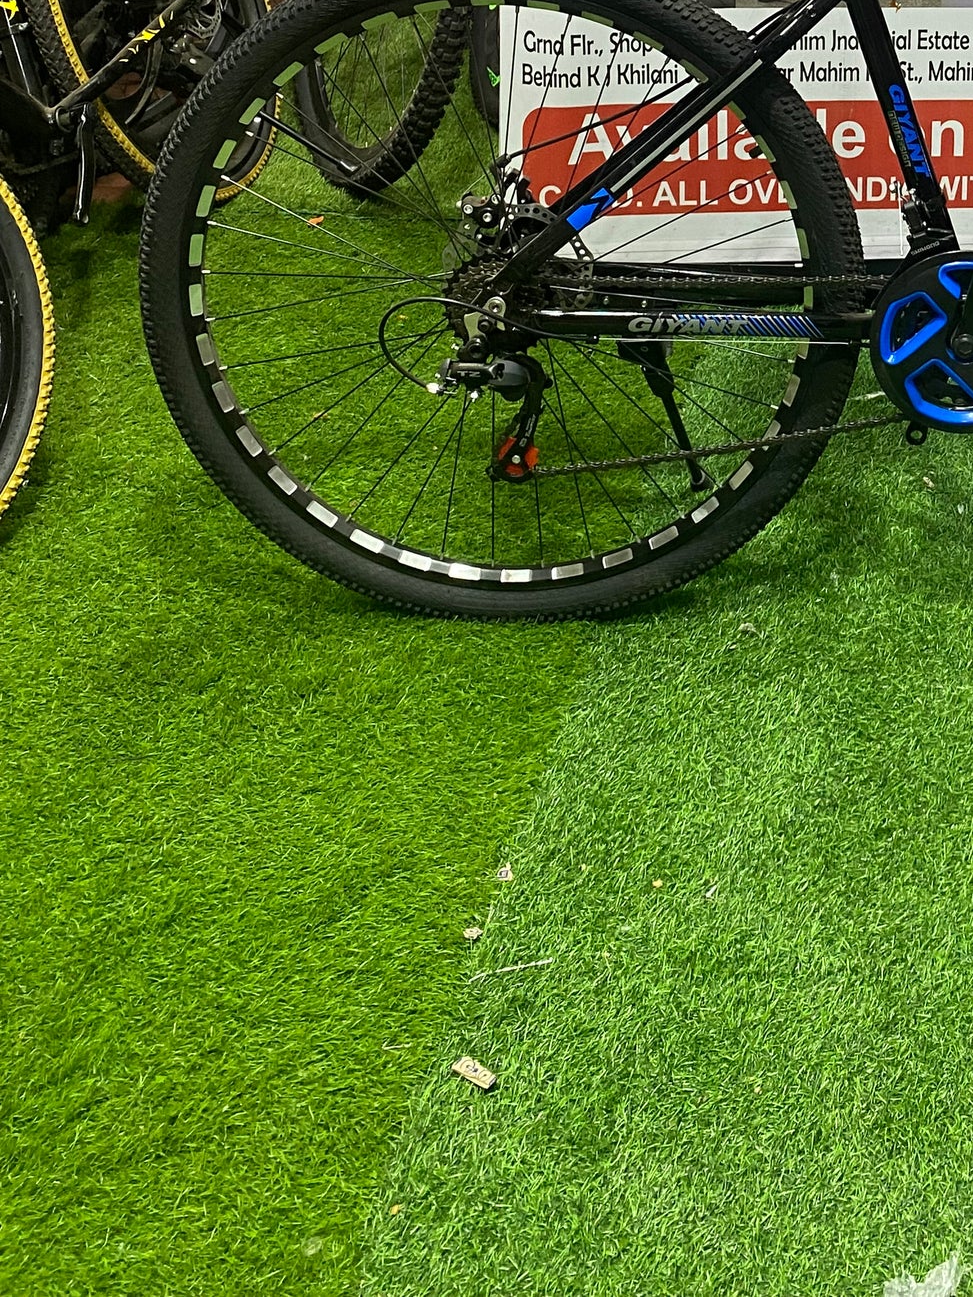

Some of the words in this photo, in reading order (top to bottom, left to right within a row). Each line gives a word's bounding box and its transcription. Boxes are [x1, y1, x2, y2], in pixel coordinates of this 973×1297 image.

[524, 30, 563, 54] Grnd
[570, 34, 604, 56] Flr.,
[917, 30, 970, 50] Estate
[522, 64, 580, 87] Behind
[588, 66, 600, 86] K
[617, 64, 678, 84] Khilani
[800, 61, 860, 82] Mahim
[888, 84, 929, 178] GIYANT
[652, 180, 718, 206] ALL
[628, 314, 750, 334] GIYANT
[456, 370, 480, 378] TZ
